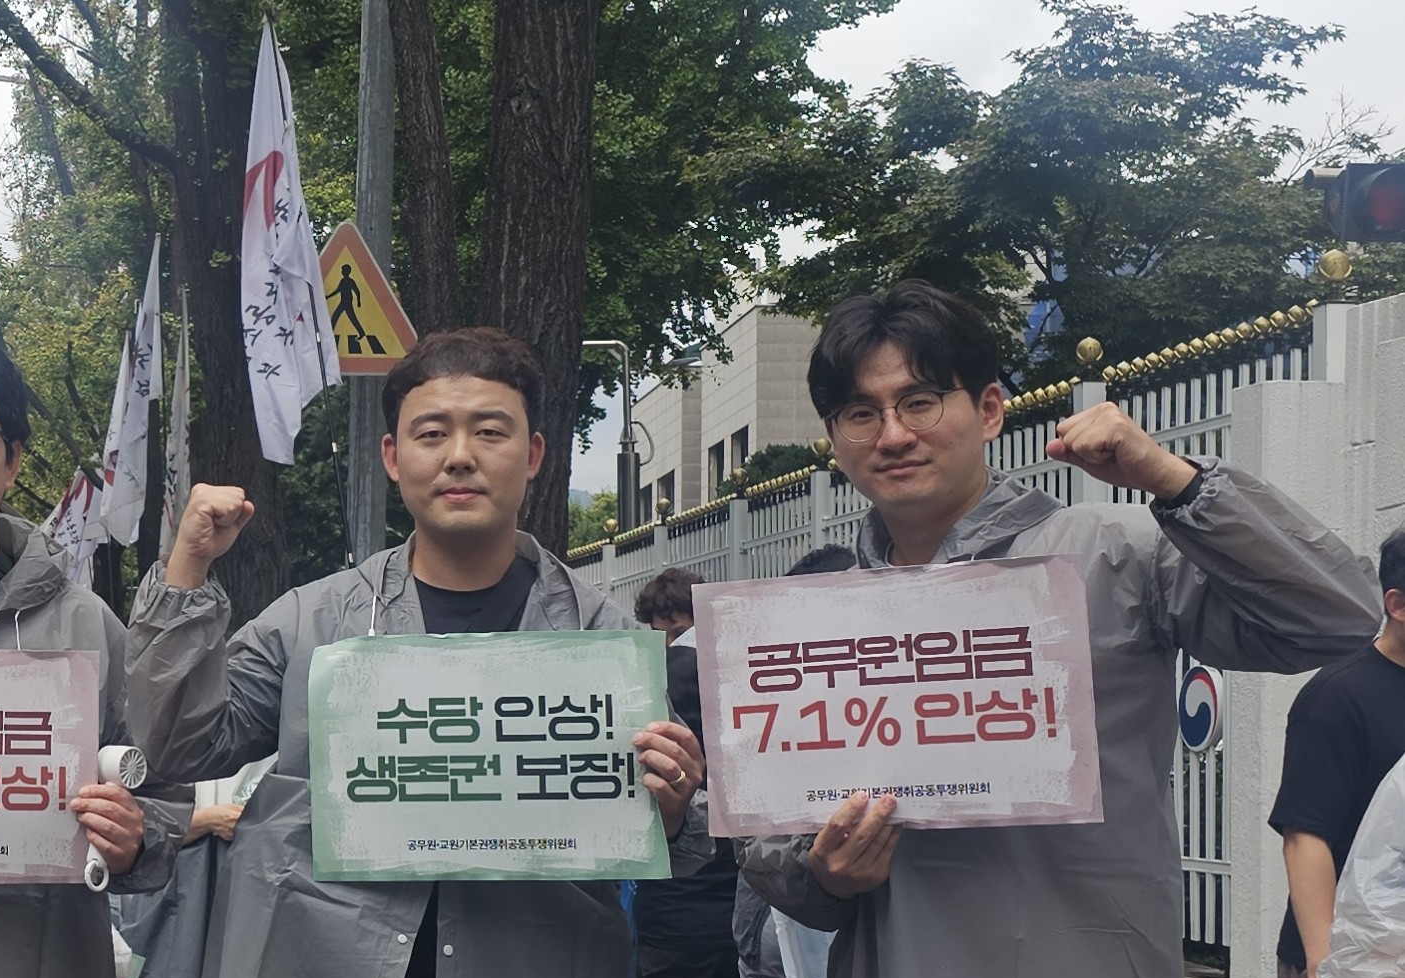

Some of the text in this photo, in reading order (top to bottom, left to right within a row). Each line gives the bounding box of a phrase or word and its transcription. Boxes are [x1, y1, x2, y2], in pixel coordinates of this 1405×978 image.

[747, 626, 1034, 693] 공무원임금
[376, 694, 614, 744] 수당 인상!
[732, 687, 1057, 754] 7.1% 인상!
[346, 752, 636, 803] 생존권 보장!
